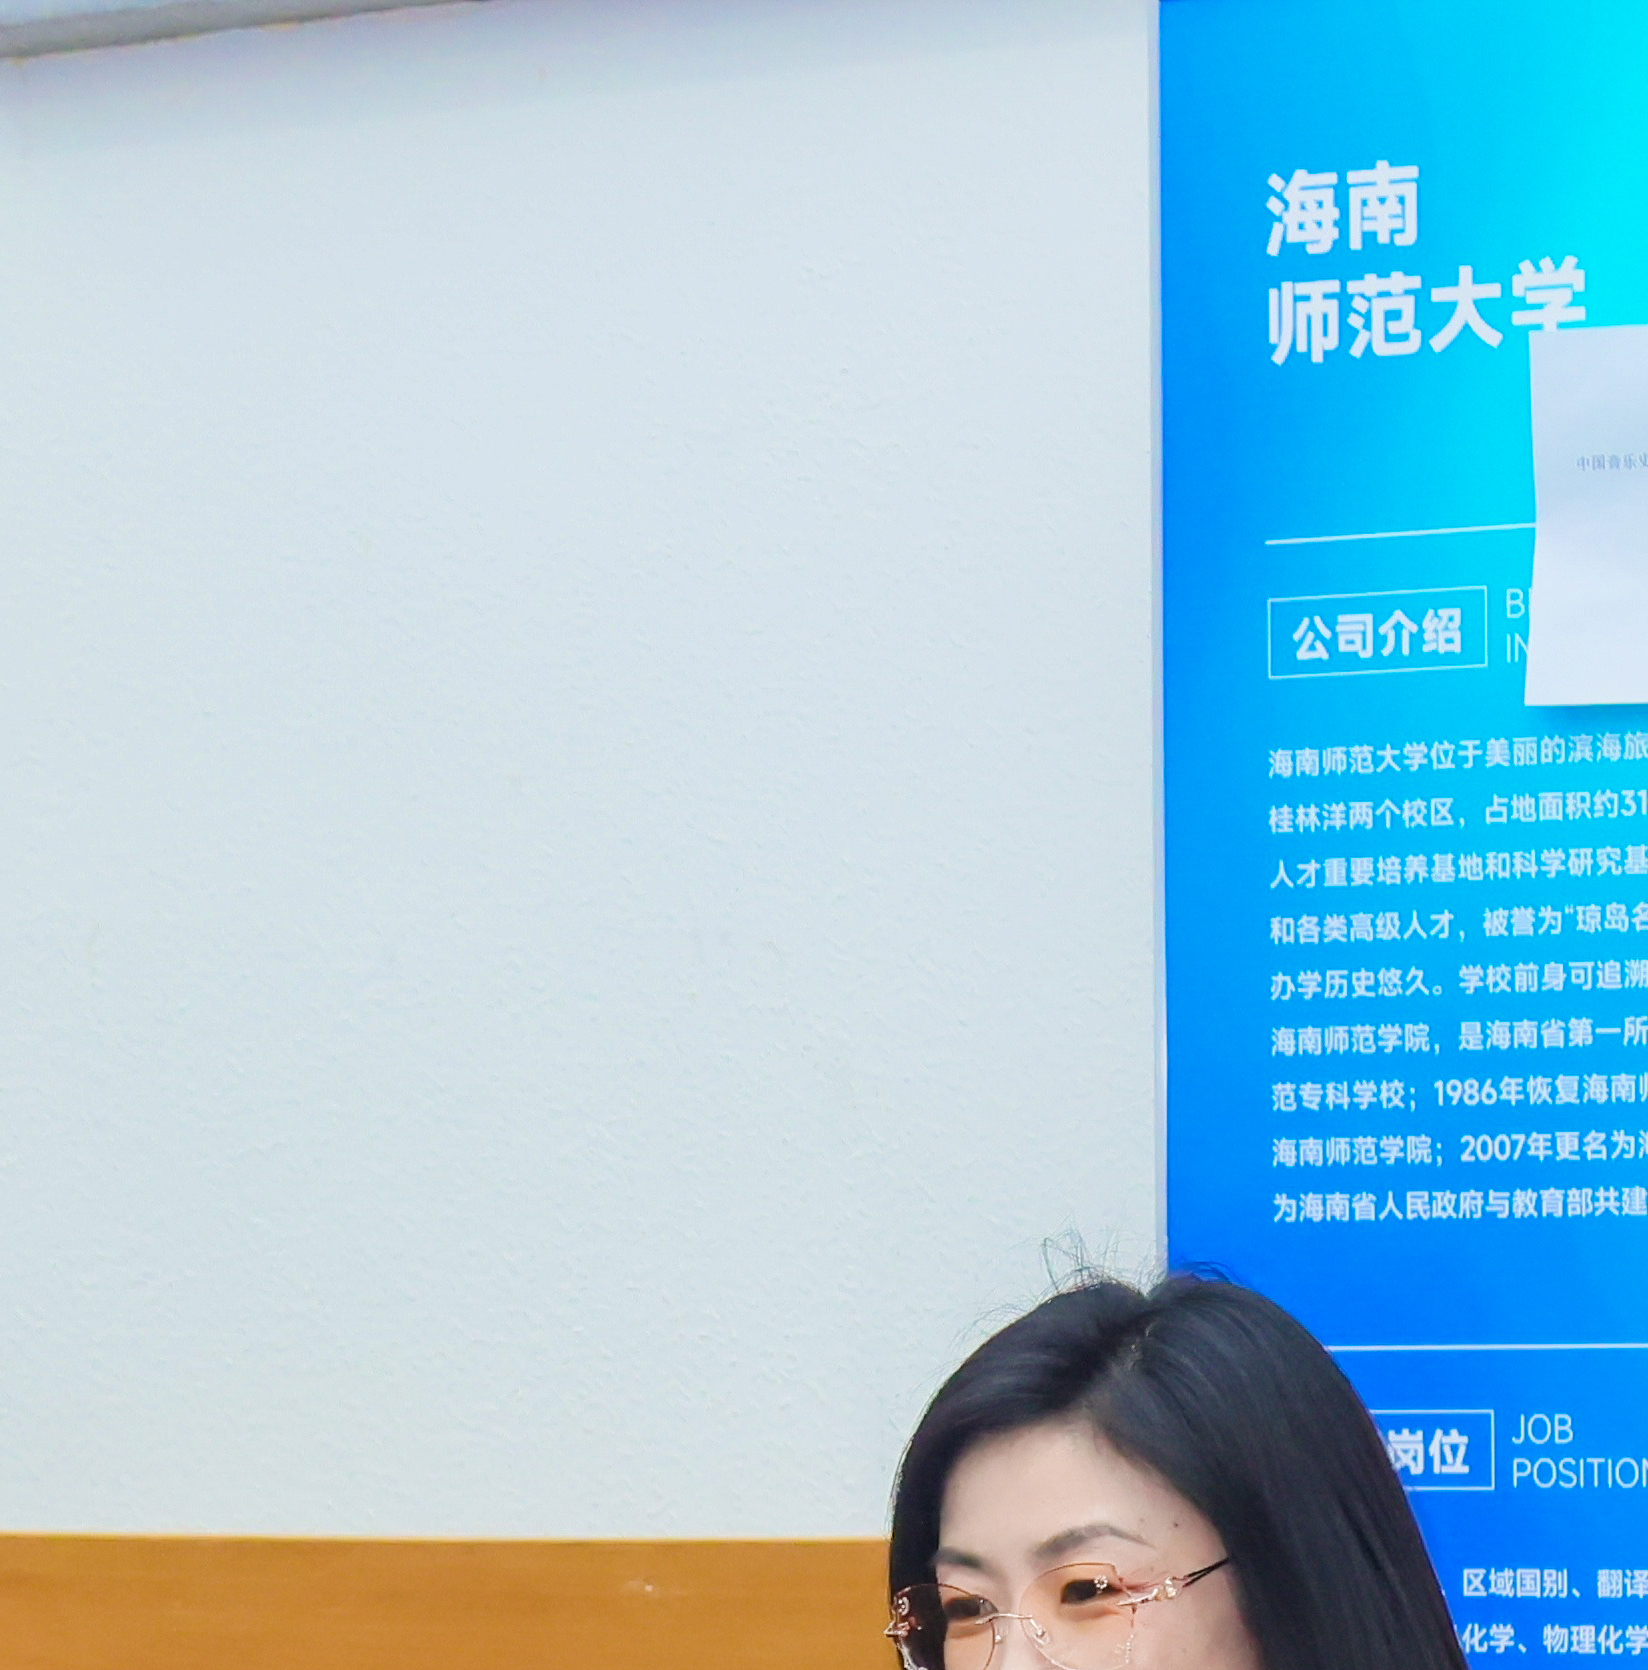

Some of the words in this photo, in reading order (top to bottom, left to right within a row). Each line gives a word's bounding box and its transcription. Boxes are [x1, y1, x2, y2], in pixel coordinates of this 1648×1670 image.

[1266, 159, 1420, 258] 海南
[1267, 254, 1587, 367] 师范大学
[1292, 606, 1462, 663] 公司介绍
[1511, 1413, 1574, 1445] JOB
